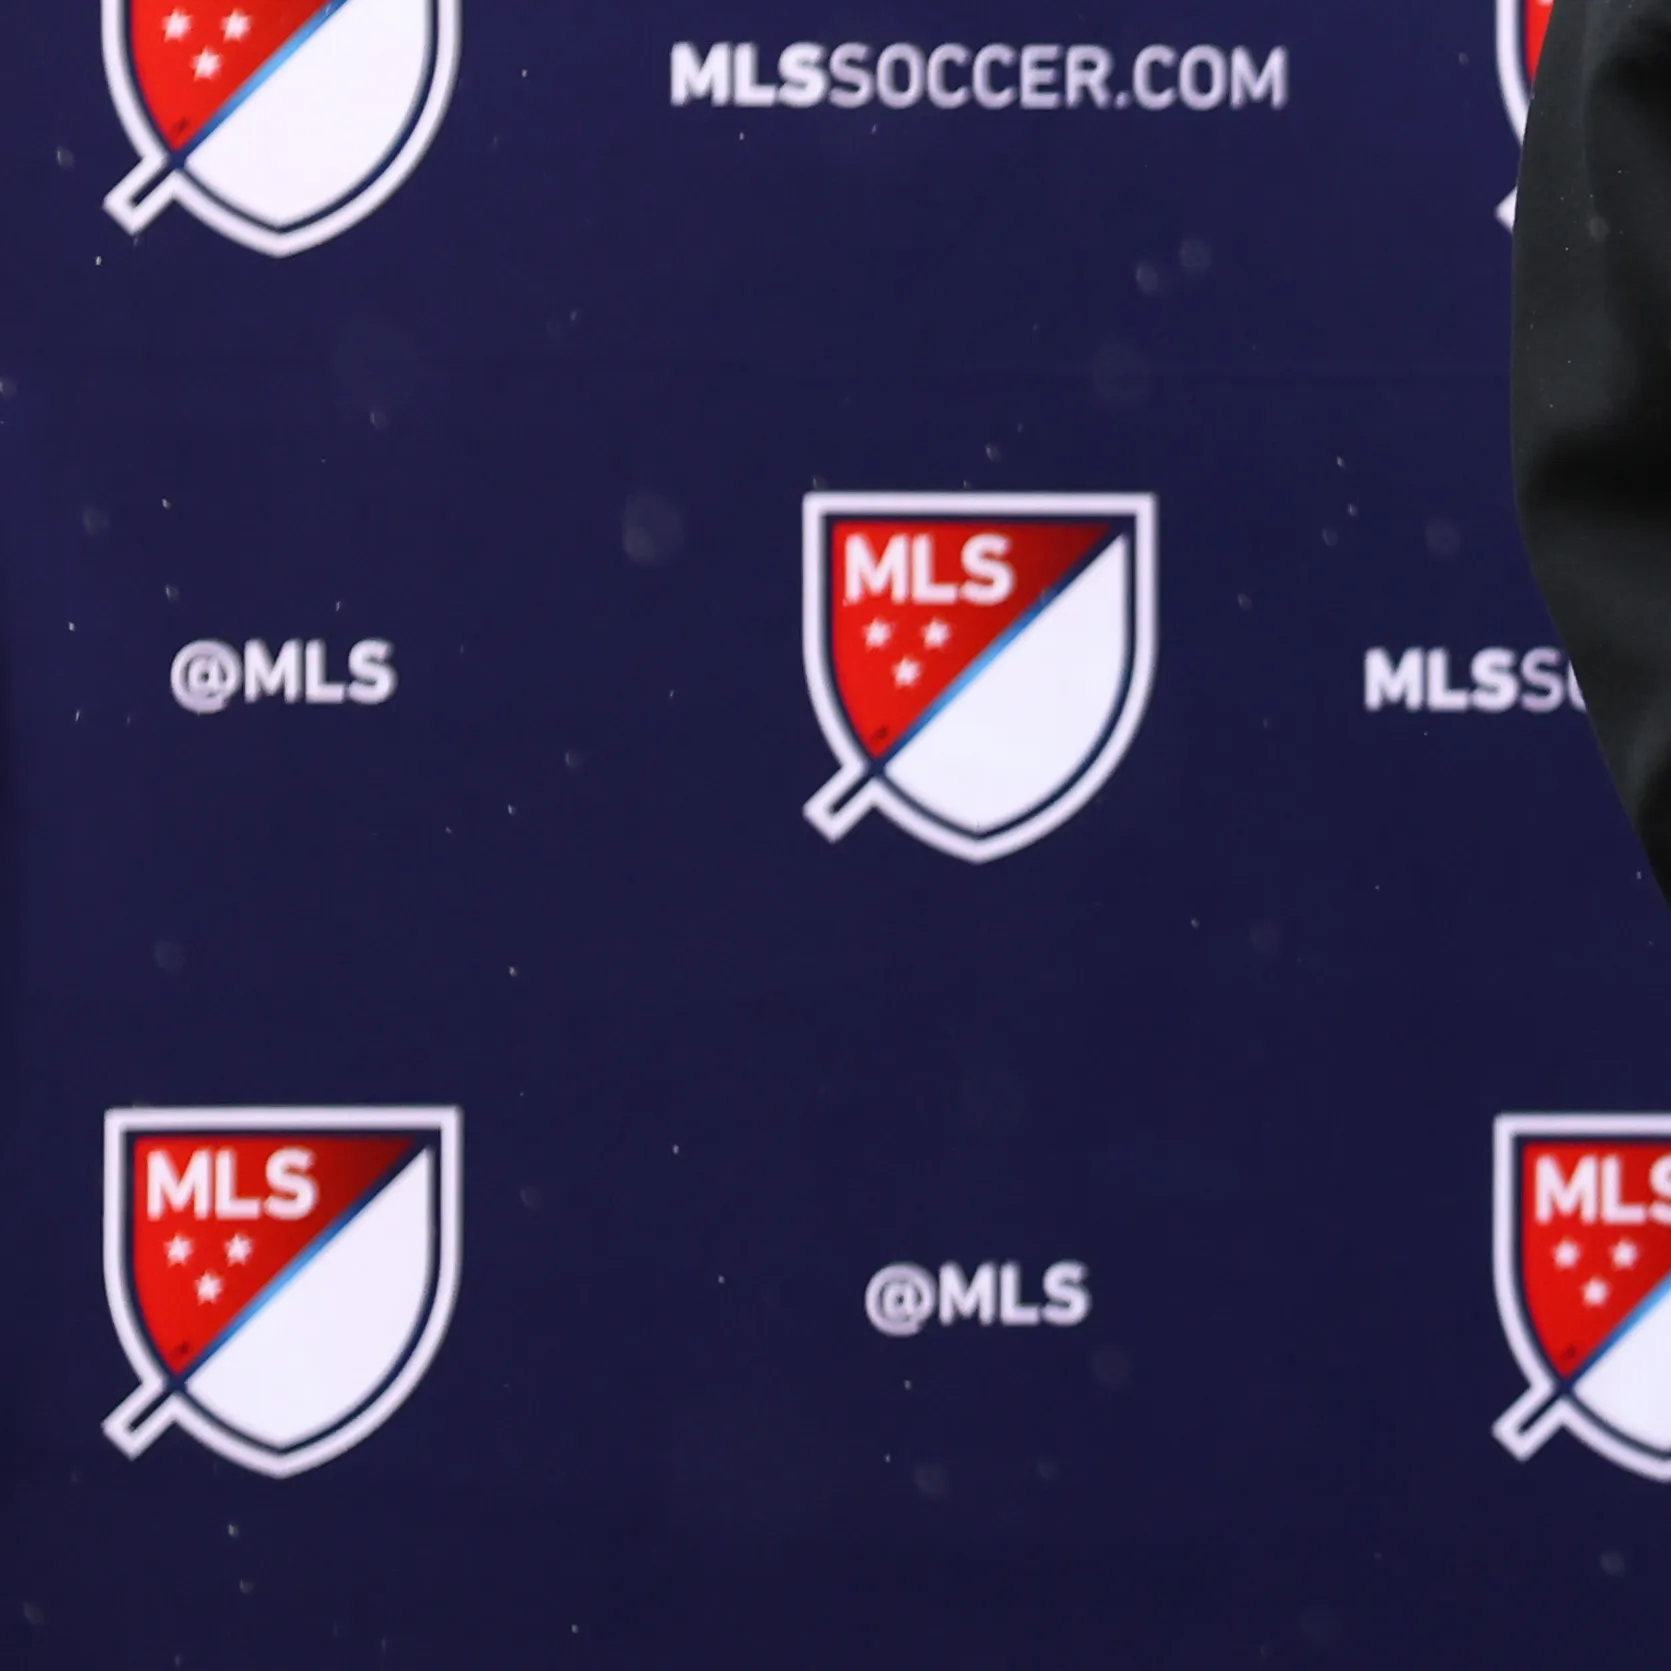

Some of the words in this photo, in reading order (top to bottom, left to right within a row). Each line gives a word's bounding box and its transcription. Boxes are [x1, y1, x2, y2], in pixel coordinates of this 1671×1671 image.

[669, 40, 1287, 110] MLSSOCCER.COM
[843, 532, 1014, 605] MLS
[168, 638, 395, 714] @MLS
[145, 1147, 317, 1220] MLS
[863, 1261, 1089, 1336] @MLS
